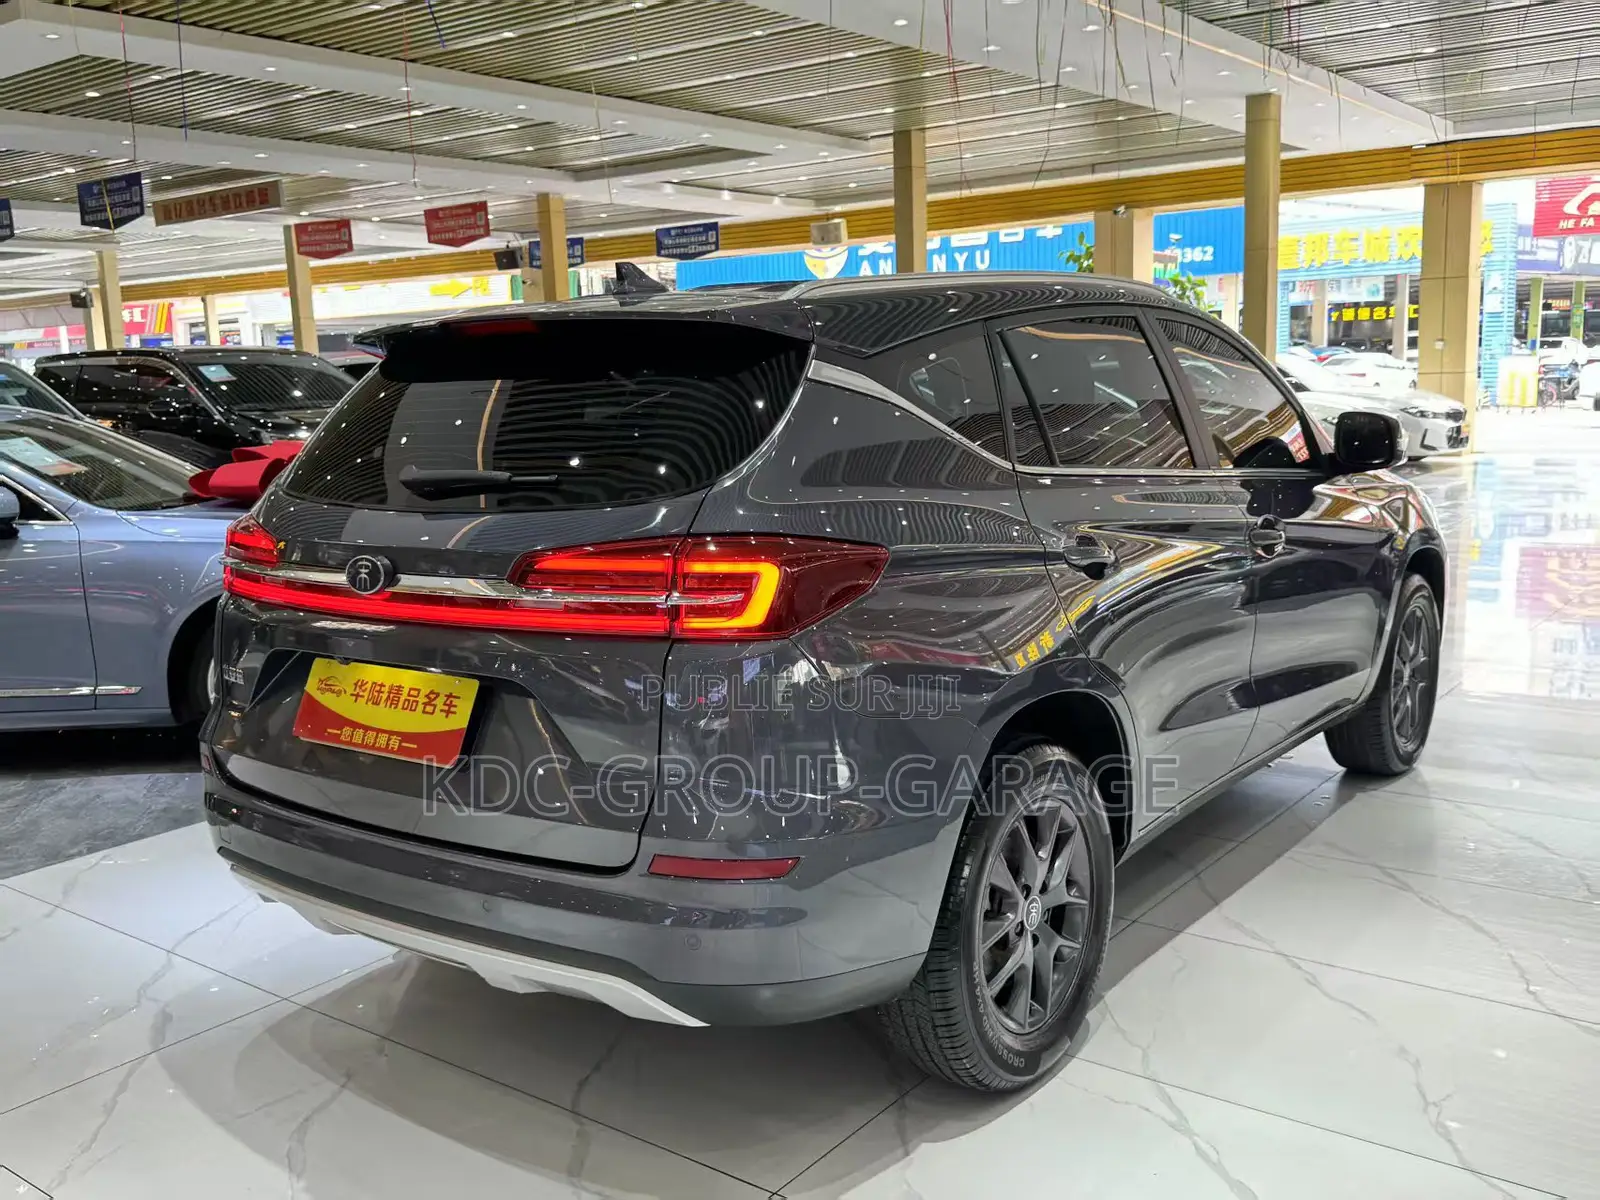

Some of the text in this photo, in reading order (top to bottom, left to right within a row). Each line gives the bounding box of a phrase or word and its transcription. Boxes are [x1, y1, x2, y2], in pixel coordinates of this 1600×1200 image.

[1559, 217, 1595, 229] HE FA
[350, 679, 461, 718] 华陆精品名车
